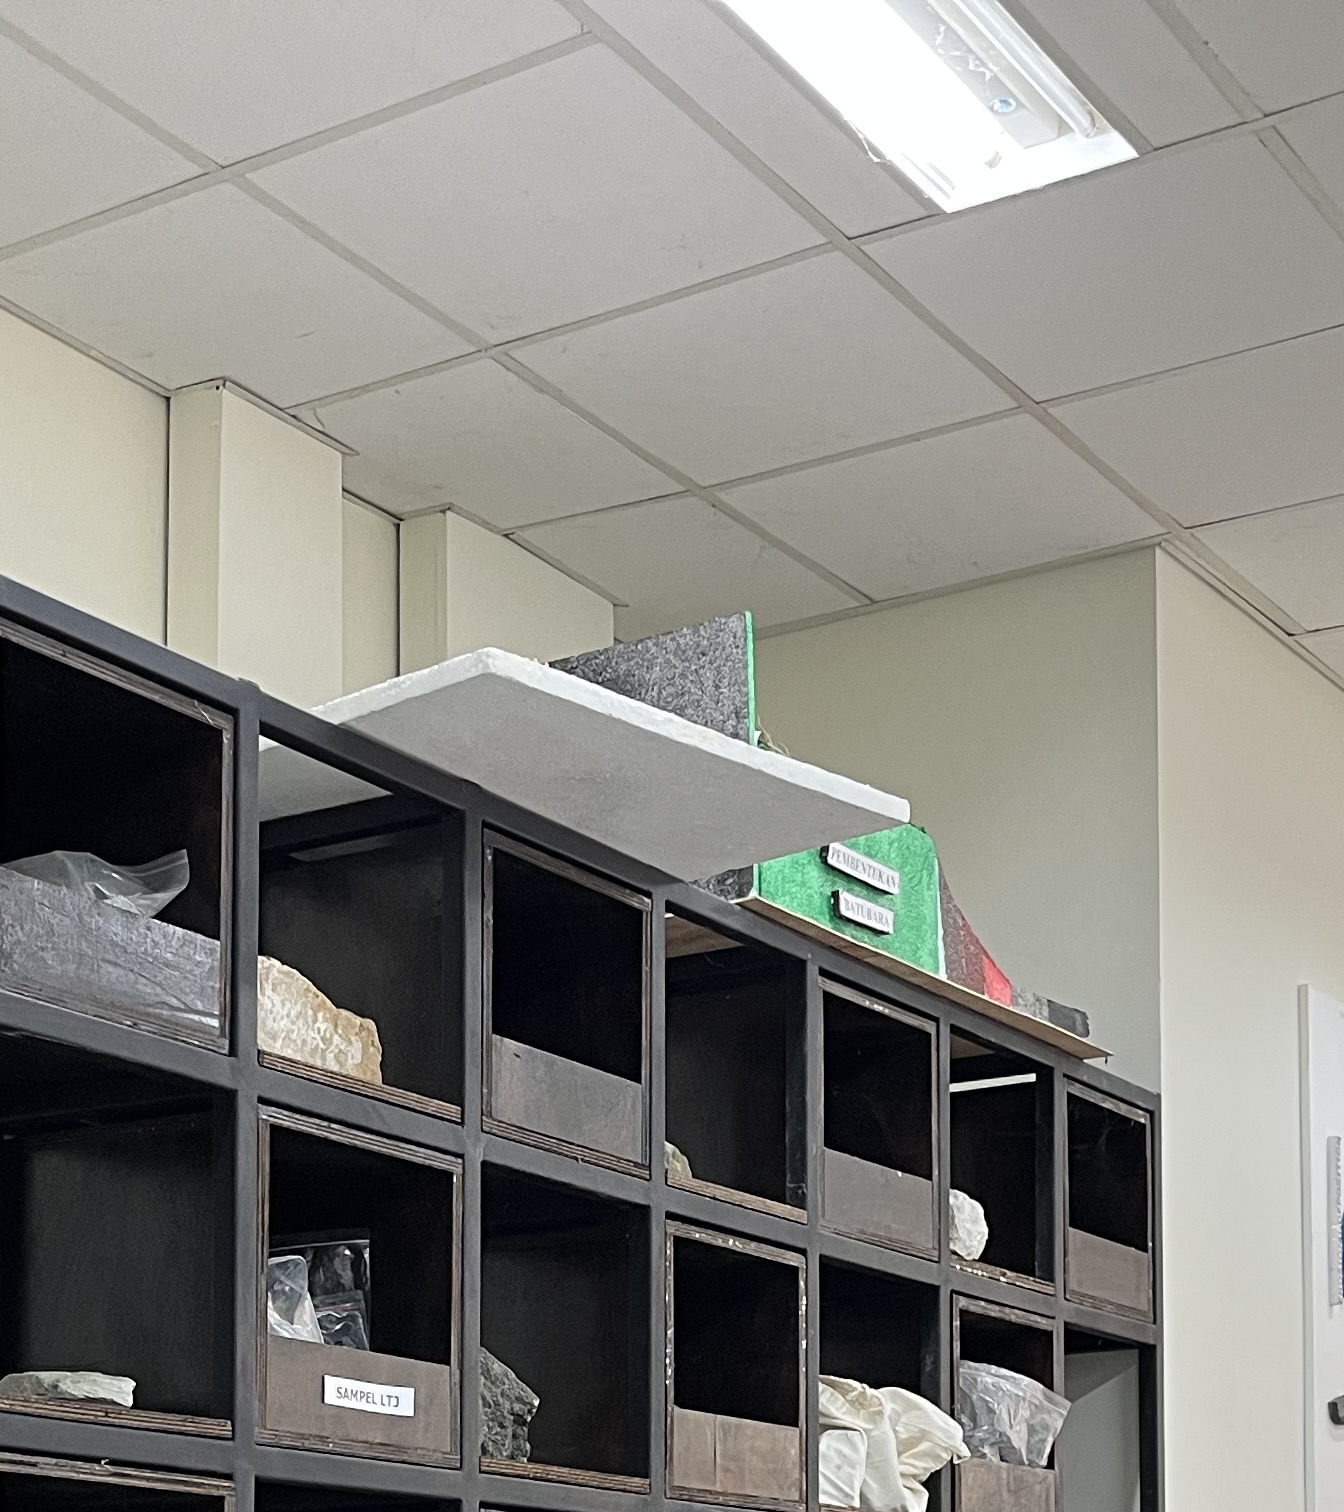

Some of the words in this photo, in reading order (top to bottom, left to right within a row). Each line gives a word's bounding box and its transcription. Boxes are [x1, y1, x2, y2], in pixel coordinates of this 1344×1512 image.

[830, 846, 896, 889] PEMBENTUKAN
[843, 896, 890, 928] BATUBARA
[335, 1386, 378, 1406] SAMPEL
[380, 1394, 400, 1408] LTJ
